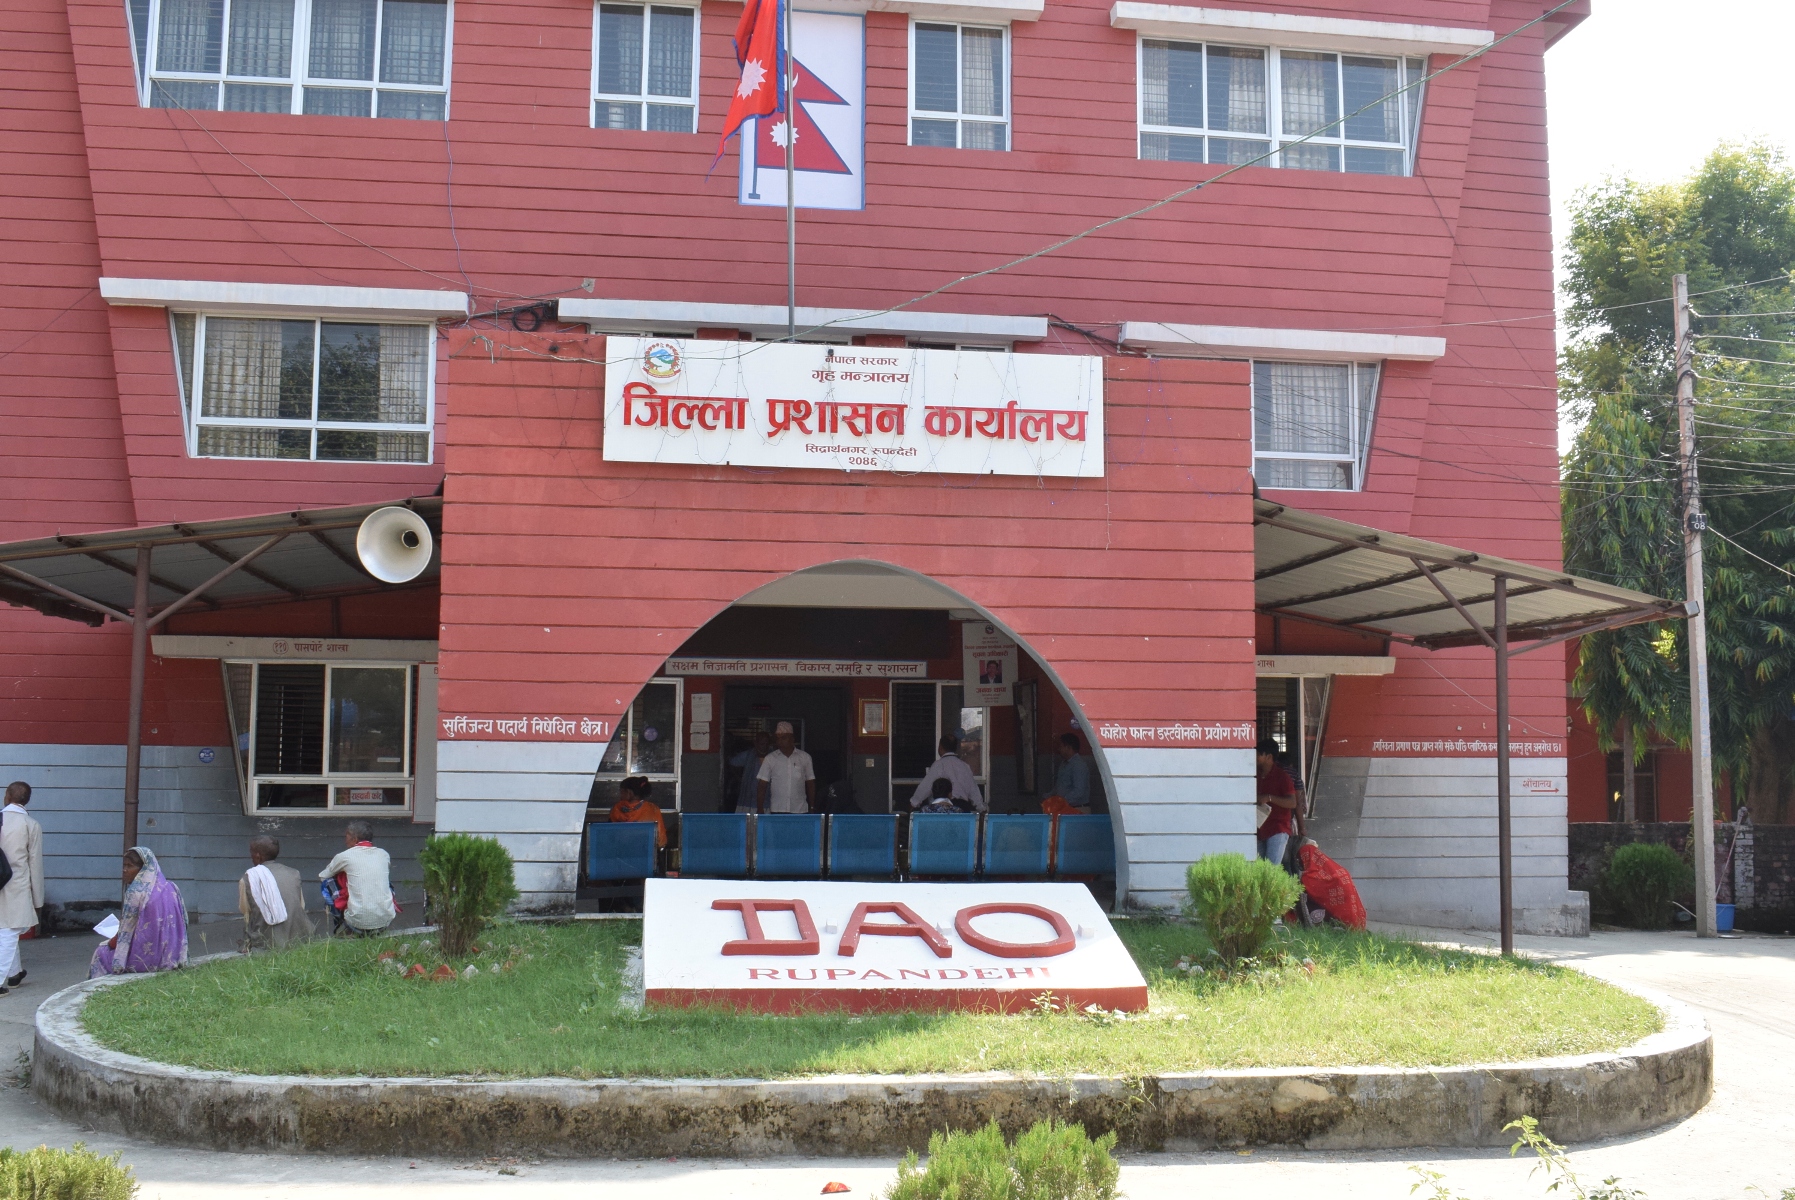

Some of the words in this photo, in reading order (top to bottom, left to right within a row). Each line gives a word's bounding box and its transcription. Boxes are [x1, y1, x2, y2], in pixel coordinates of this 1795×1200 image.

[859, 356, 900, 367] सरकार
[811, 369, 837, 384] गृह
[840, 371, 911, 384] मन्त्रालय
[623, 381, 749, 431] जिल्ला
[766, 397, 908, 438] प्रशासन
[924, 400, 1089, 443] कार्यालय
[848, 456, 878, 467] २०४६
[294, 640, 323, 653] पासपोर्ट
[326, 644, 349, 653] शाखा
[865, 664, 873, 674] र
[1257, 659, 1275, 668] शाखा
[496, 716, 528, 736] पदार्थ
[531, 717, 577, 736] निषेधित
[1100, 723, 1128, 742] फोहोर
[1204, 723, 1231, 741] प्रयोग
[746, 967, 1051, 981] RUPANDEHI
